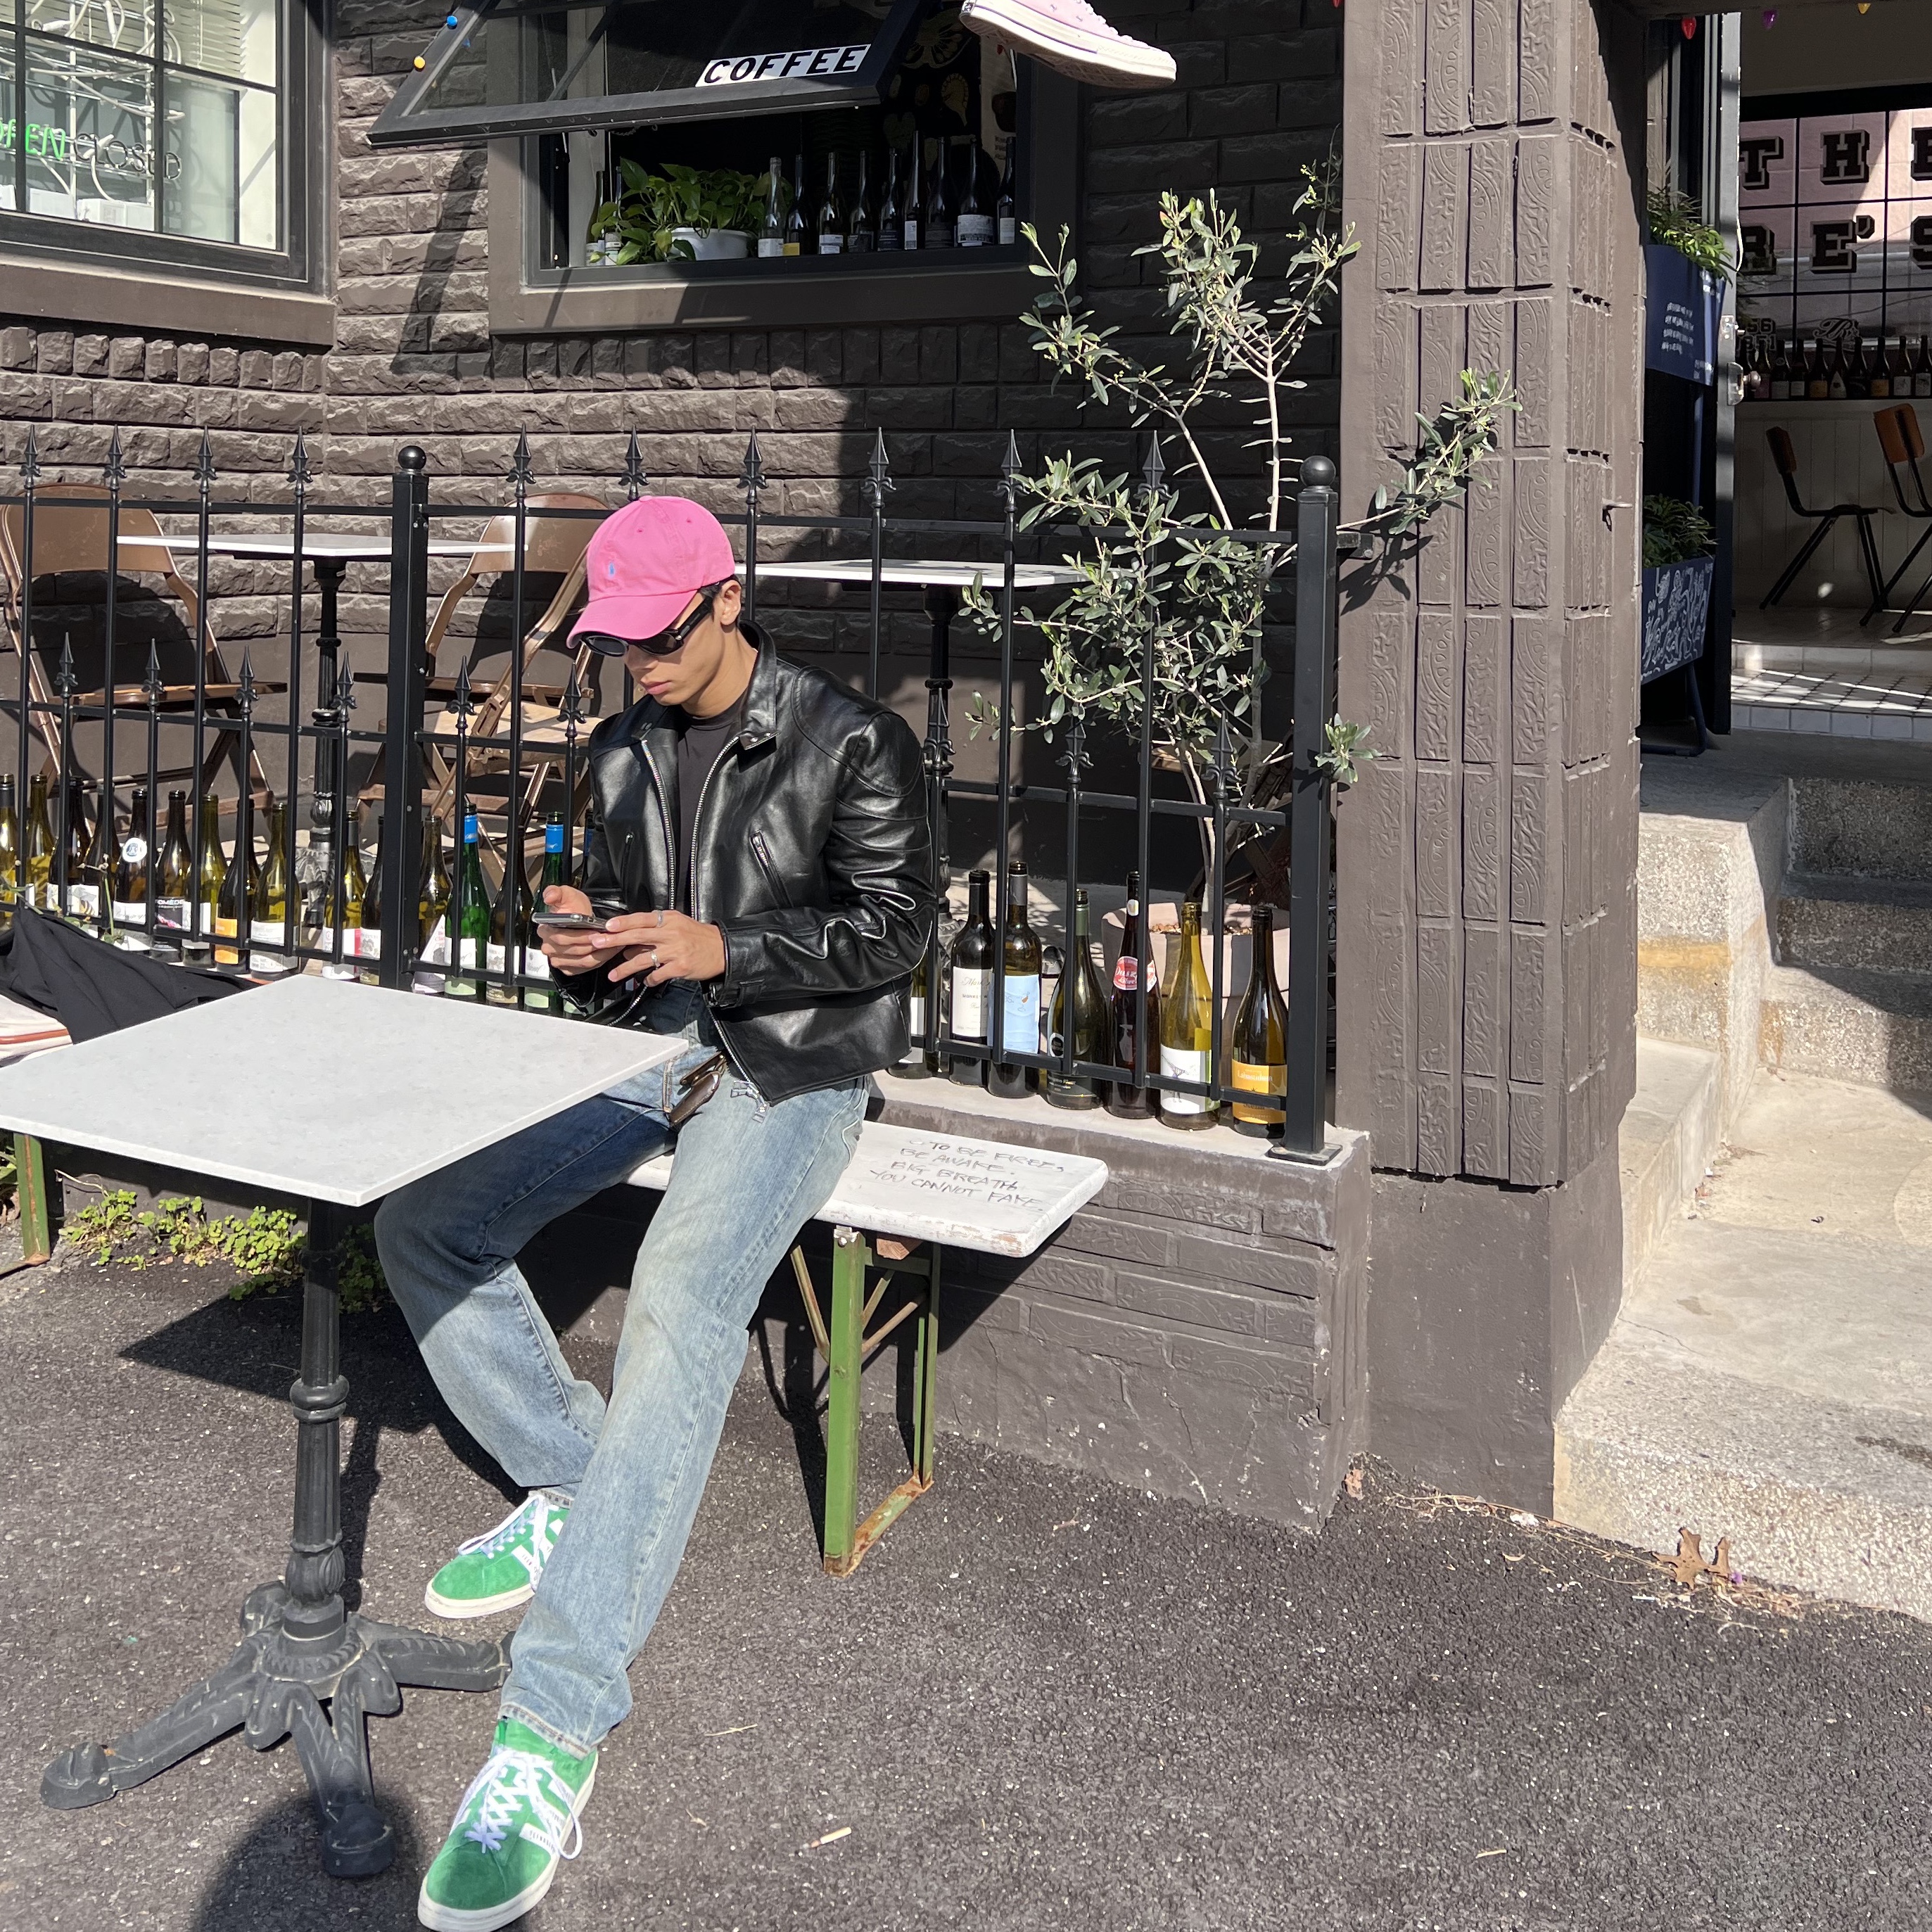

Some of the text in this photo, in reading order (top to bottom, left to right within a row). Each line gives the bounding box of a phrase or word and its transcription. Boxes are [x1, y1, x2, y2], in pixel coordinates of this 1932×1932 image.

[704, 46, 867, 83] COFFEE
[0, 118, 65, 160] PEN
[901, 1148, 929, 1159] BE
[929, 1141, 951, 1150] TO
[957, 1146, 986, 1157] BE
[891, 1162, 930, 1175] BIG
[870, 1170, 906, 1183] YOU
[911, 1178, 983, 1197] CANNOT
